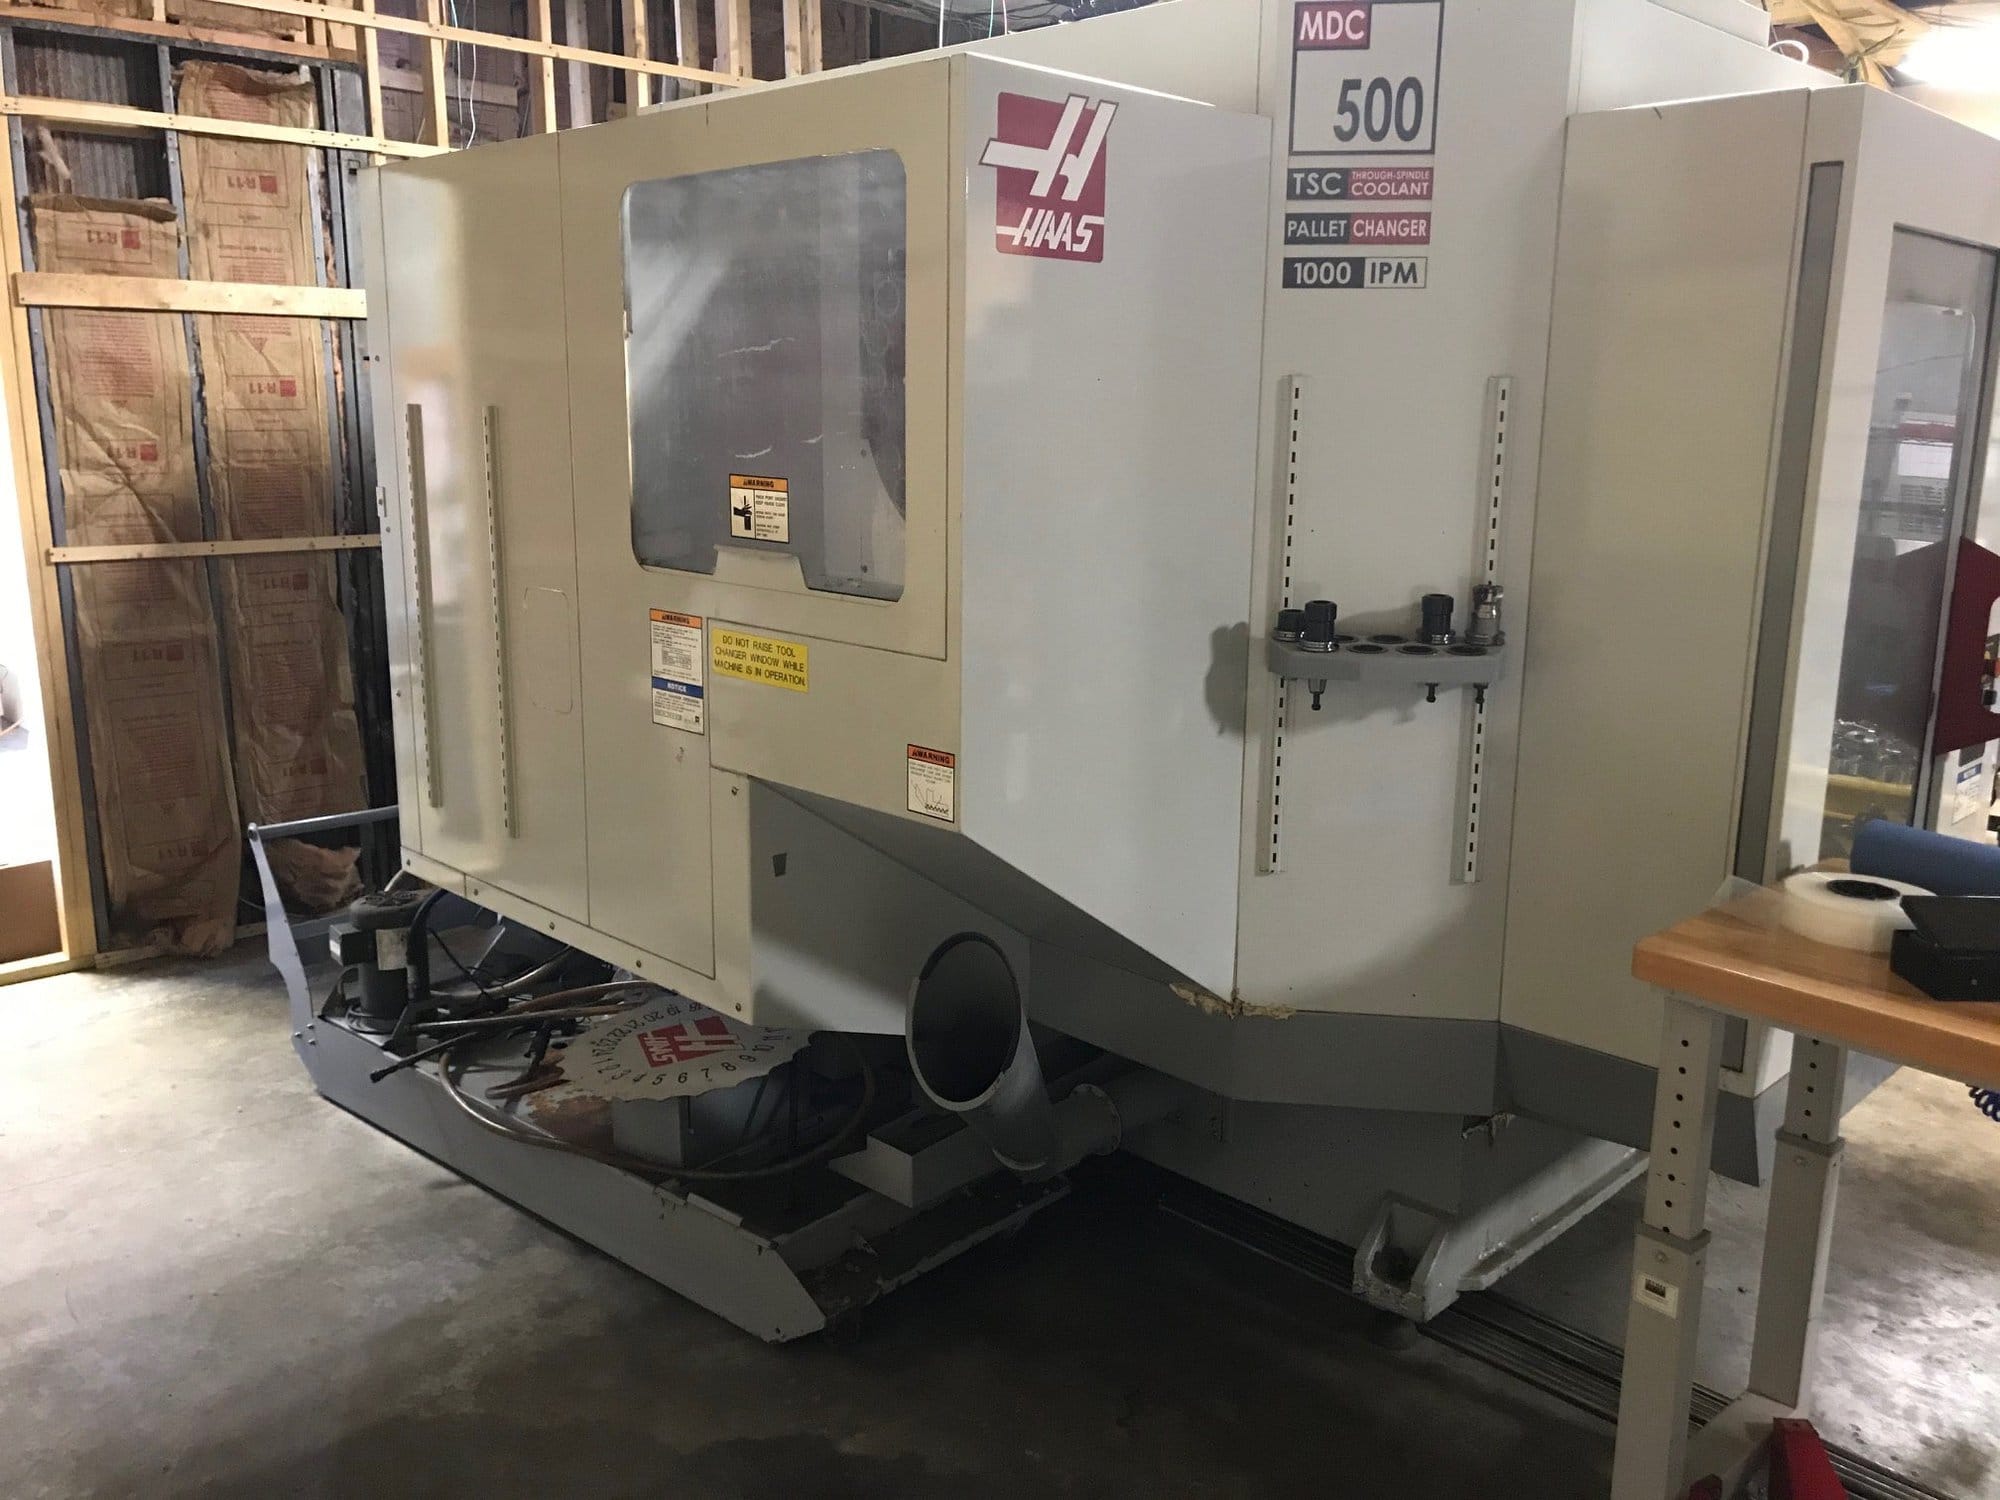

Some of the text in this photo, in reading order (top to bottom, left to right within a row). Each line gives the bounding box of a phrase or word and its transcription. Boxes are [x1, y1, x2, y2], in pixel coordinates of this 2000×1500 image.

[1300, 10, 1366, 41] MDC
[1333, 76, 1424, 142] 500
[1293, 170, 1430, 196] TSC THROUGH-SPINDLE
[1351, 182, 1429, 197] COOLANT
[996, 207, 1105, 253] HAAS
[1287, 218, 1427, 238] PALLET CHANGER
[1293, 262, 1418, 285] 1000 IPM
[722, 634, 797, 658] DO NOT RAISE TOOL
[713, 658, 744, 673] MACHINE
[745, 665, 753, 675] IS
[754, 667, 762, 677] IN
[715, 646, 805, 673] CHANGER WINDOW WHILE
[916, 751, 950, 765] WARNING
[643, 1011, 664, 1023] 20
[721, 1062, 737, 1072] 8
[739, 1054, 757, 1063] 9
[652, 1073, 667, 1086] 5
[677, 1072, 688, 1084] 6
[701, 1067, 710, 1079] 7
